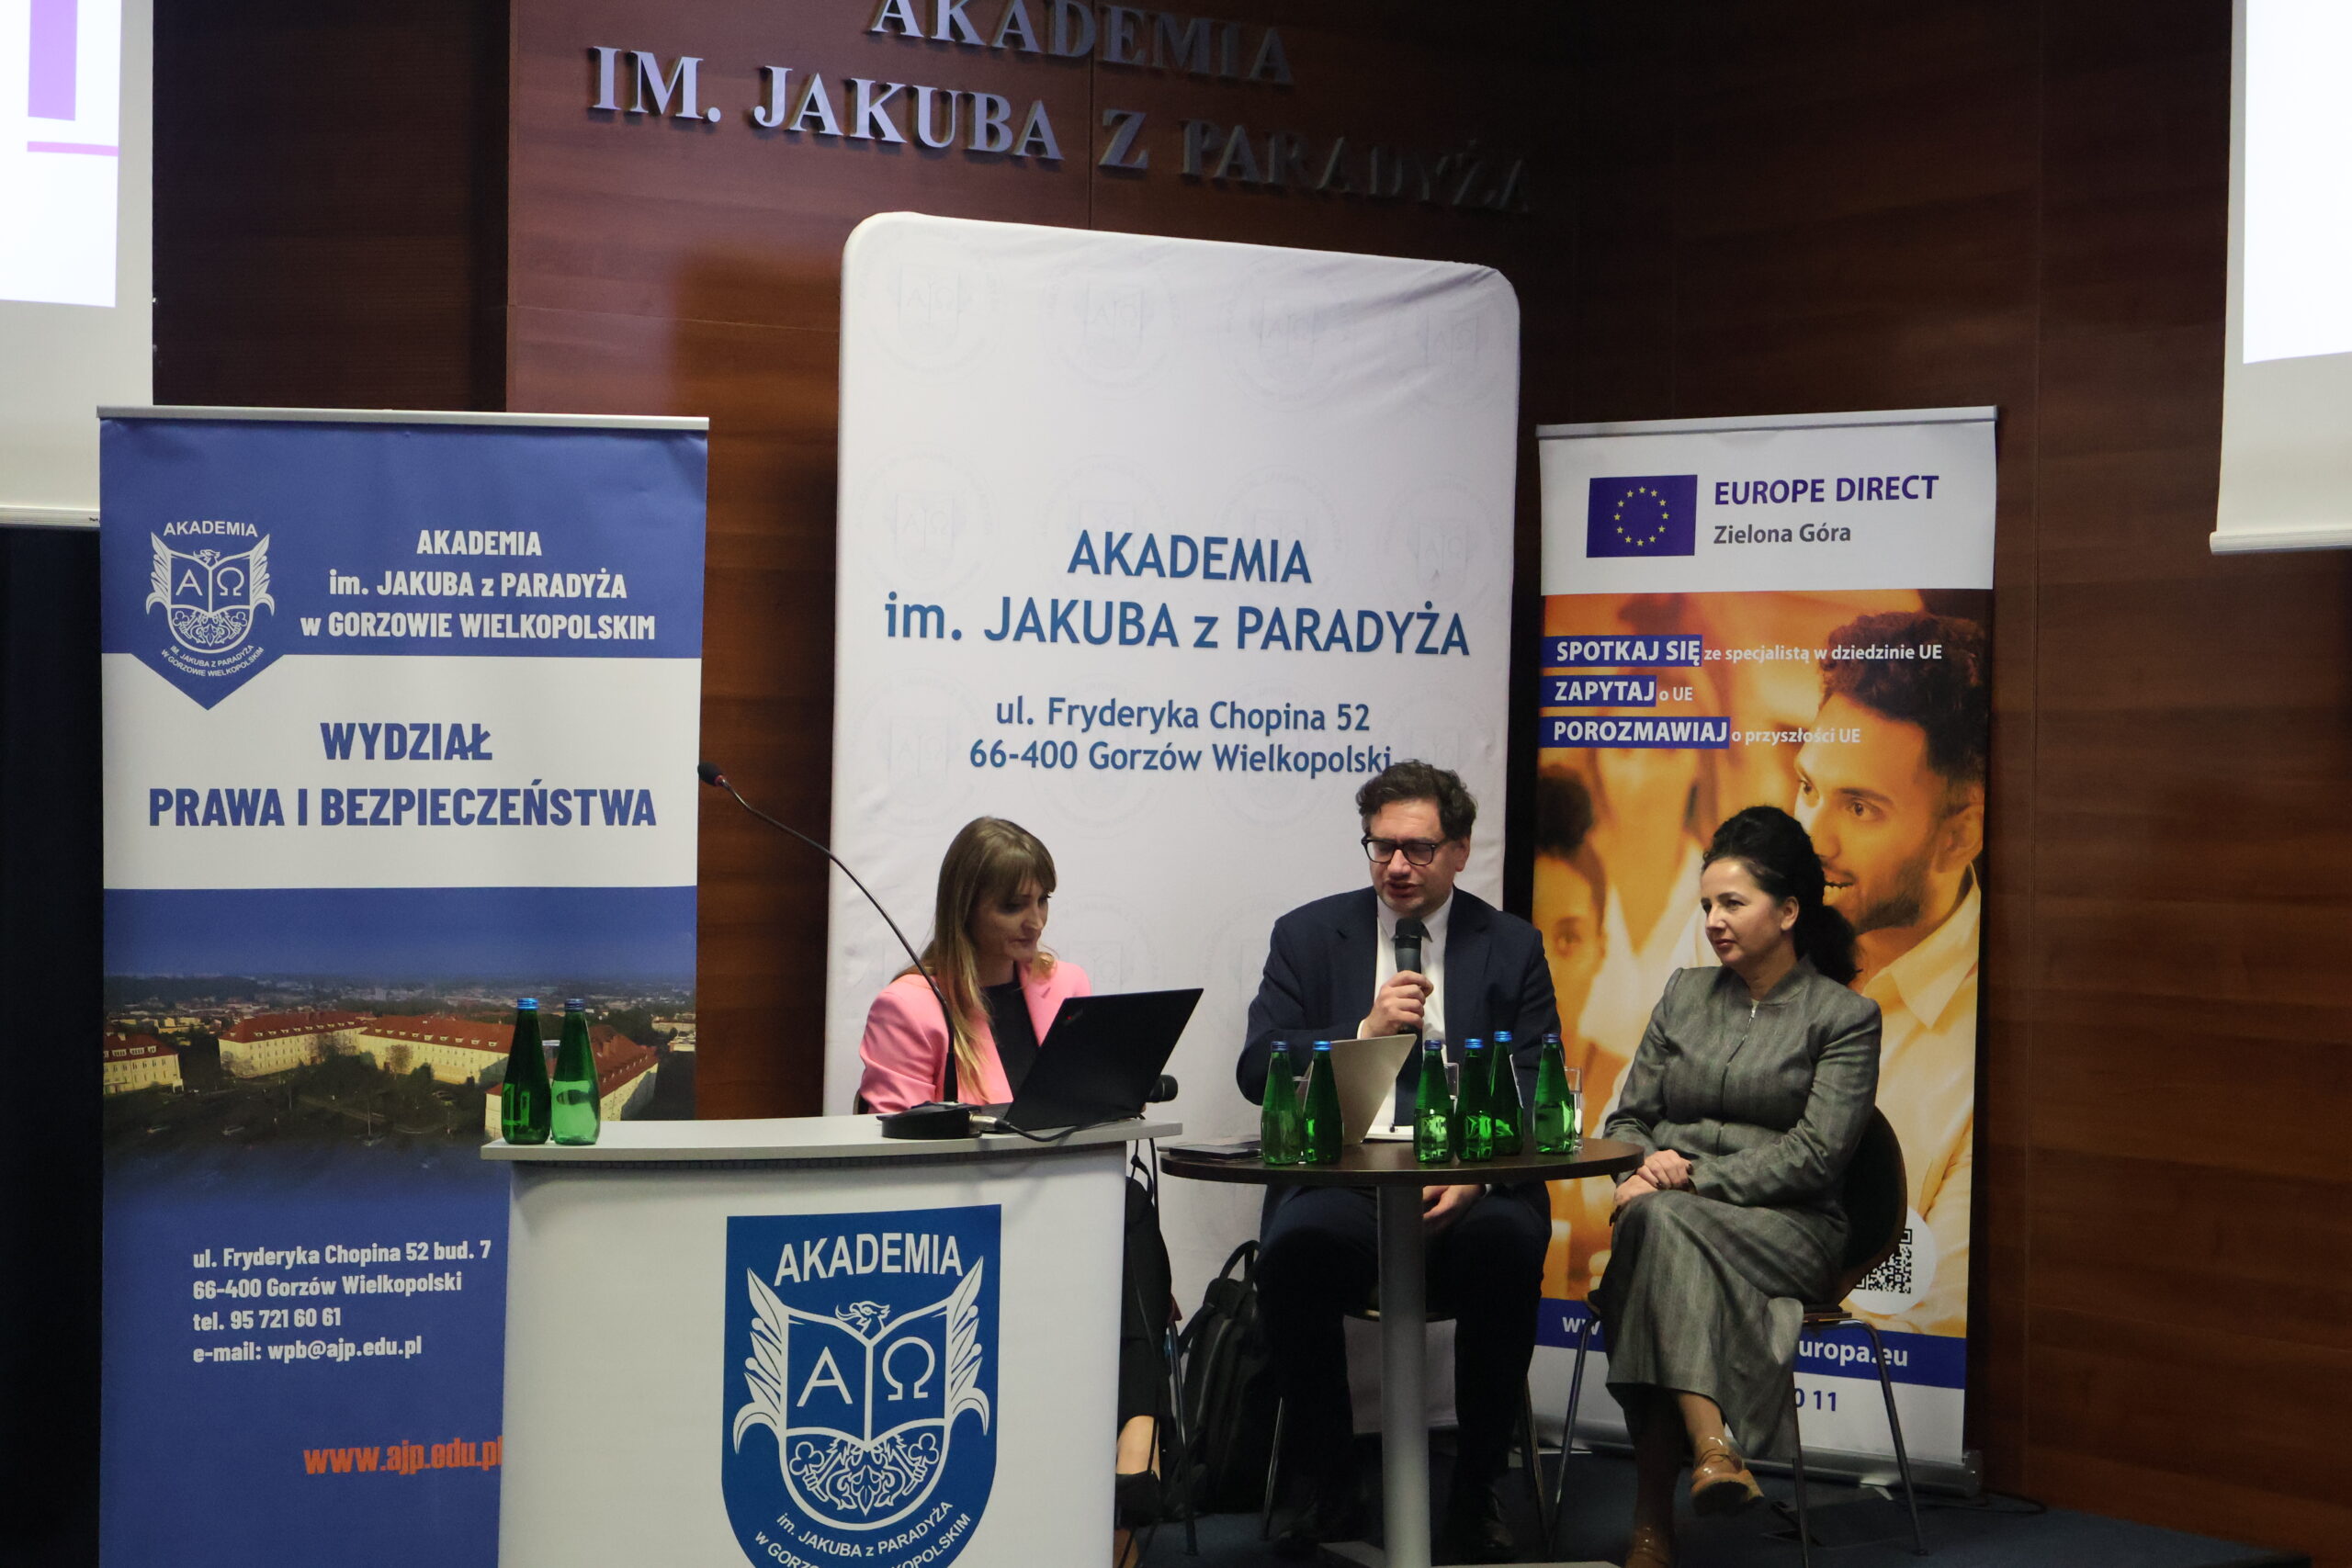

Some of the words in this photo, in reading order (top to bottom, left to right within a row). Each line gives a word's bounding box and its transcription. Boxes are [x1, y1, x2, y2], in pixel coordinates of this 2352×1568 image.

[868, 0, 1294, 85] AKADEMIA
[591, 45, 721, 122] IM.
[752, 64, 1064, 161] JAKUBA
[1098, 107, 1148, 170] Z
[1714, 479, 1825, 505] EUROPE
[1836, 475, 1939, 502] DIRECT
[163, 520, 258, 537] AKADEMIA
[416, 529, 542, 557] AKADEMIA
[1713, 524, 1792, 545] Zielona
[1799, 522, 1851, 543] Góra
[1067, 529, 1313, 584] AKADEMIA
[329, 569, 369, 595] im.
[377, 570, 475, 597] JAKUBA
[481, 578, 494, 597] z
[501, 567, 628, 599] PARADYŻA
[300, 617, 322, 637] w
[328, 611, 453, 637] GORZOWIE
[458, 613, 655, 640] WIELKOPOLSKIM
[885, 591, 962, 641] im.
[984, 596, 1180, 648] JAKUBA
[1193, 615, 1219, 649] z
[1238, 600, 1470, 657] PARADYŻA
[168, 657, 207, 676] GORZOWIE
[208, 647, 265, 676] WIELKOPOLSKIM
[180, 654, 209, 667] JAKUBA
[1556, 640, 1659, 661] SPOTKAJ
[1665, 639, 1701, 667] SIĘ
[1703, 649, 1722, 660] ze
[1724, 645, 1810, 663] specjalistą
[1814, 649, 1828, 660] w
[1831, 644, 1915, 660] dziedzinie
[1919, 644, 1943, 660] UE
[1555, 681, 1655, 702] ZAPYTAJ
[1658, 690, 1669, 702] o
[1672, 686, 1693, 702] UE
[996, 694, 1034, 726] ul.
[1048, 696, 1199, 732] Fryderyka
[1210, 700, 1326, 738] Chopina
[1337, 703, 1370, 731] 52
[320, 722, 493, 761] WYDZIAŁ
[1554, 720, 1727, 742] POROZMAWIAJ
[1731, 730, 1742, 742] o
[1745, 728, 1836, 746] przyszłości
[1838, 728, 1861, 743] UE
[969, 739, 1078, 770] 66-400
[1089, 740, 1203, 772] Gorzów
[1211, 742, 1392, 780] Wielkopolski
[149, 788, 285, 827] PRAWA
[298, 788, 308, 827] I
[321, 778, 657, 827] BEZPIECZEŃSTWA
[193, 1248, 218, 1269] ul.
[223, 1246, 321, 1271] Fryderyka
[324, 1242, 401, 1268] Chopina
[405, 1241, 429, 1261] 52
[434, 1240, 475, 1260] bud.
[480, 1239, 492, 1258] 7
[774, 1232, 964, 1287] AKADEMIA
[193, 1278, 262, 1300] 66-400
[266, 1276, 337, 1297] Gorzów
[341, 1270, 462, 1297] Wielkopolski
[192, 1311, 225, 1332] tel.
[230, 1310, 254, 1330] 95
[258, 1309, 288, 1329] 721
[293, 1307, 318, 1328] 60
[322, 1307, 341, 1326] 61
[193, 1340, 262, 1363] e-mail:
[267, 1335, 422, 1364] wpb@ajp.edu.pl
[1798, 1339, 1908, 1367] uropa.eu
[1813, 1390, 1837, 1412] 11
[303, 1436, 503, 1475] www.ajp.edu.pl
[754, 1530, 770, 1545] w
[775, 1512, 795, 1536] im.
[797, 1530, 863, 1558] JAKUBA
[865, 1546, 875, 1557] z
[877, 1500, 954, 1555] PARADYŻA
